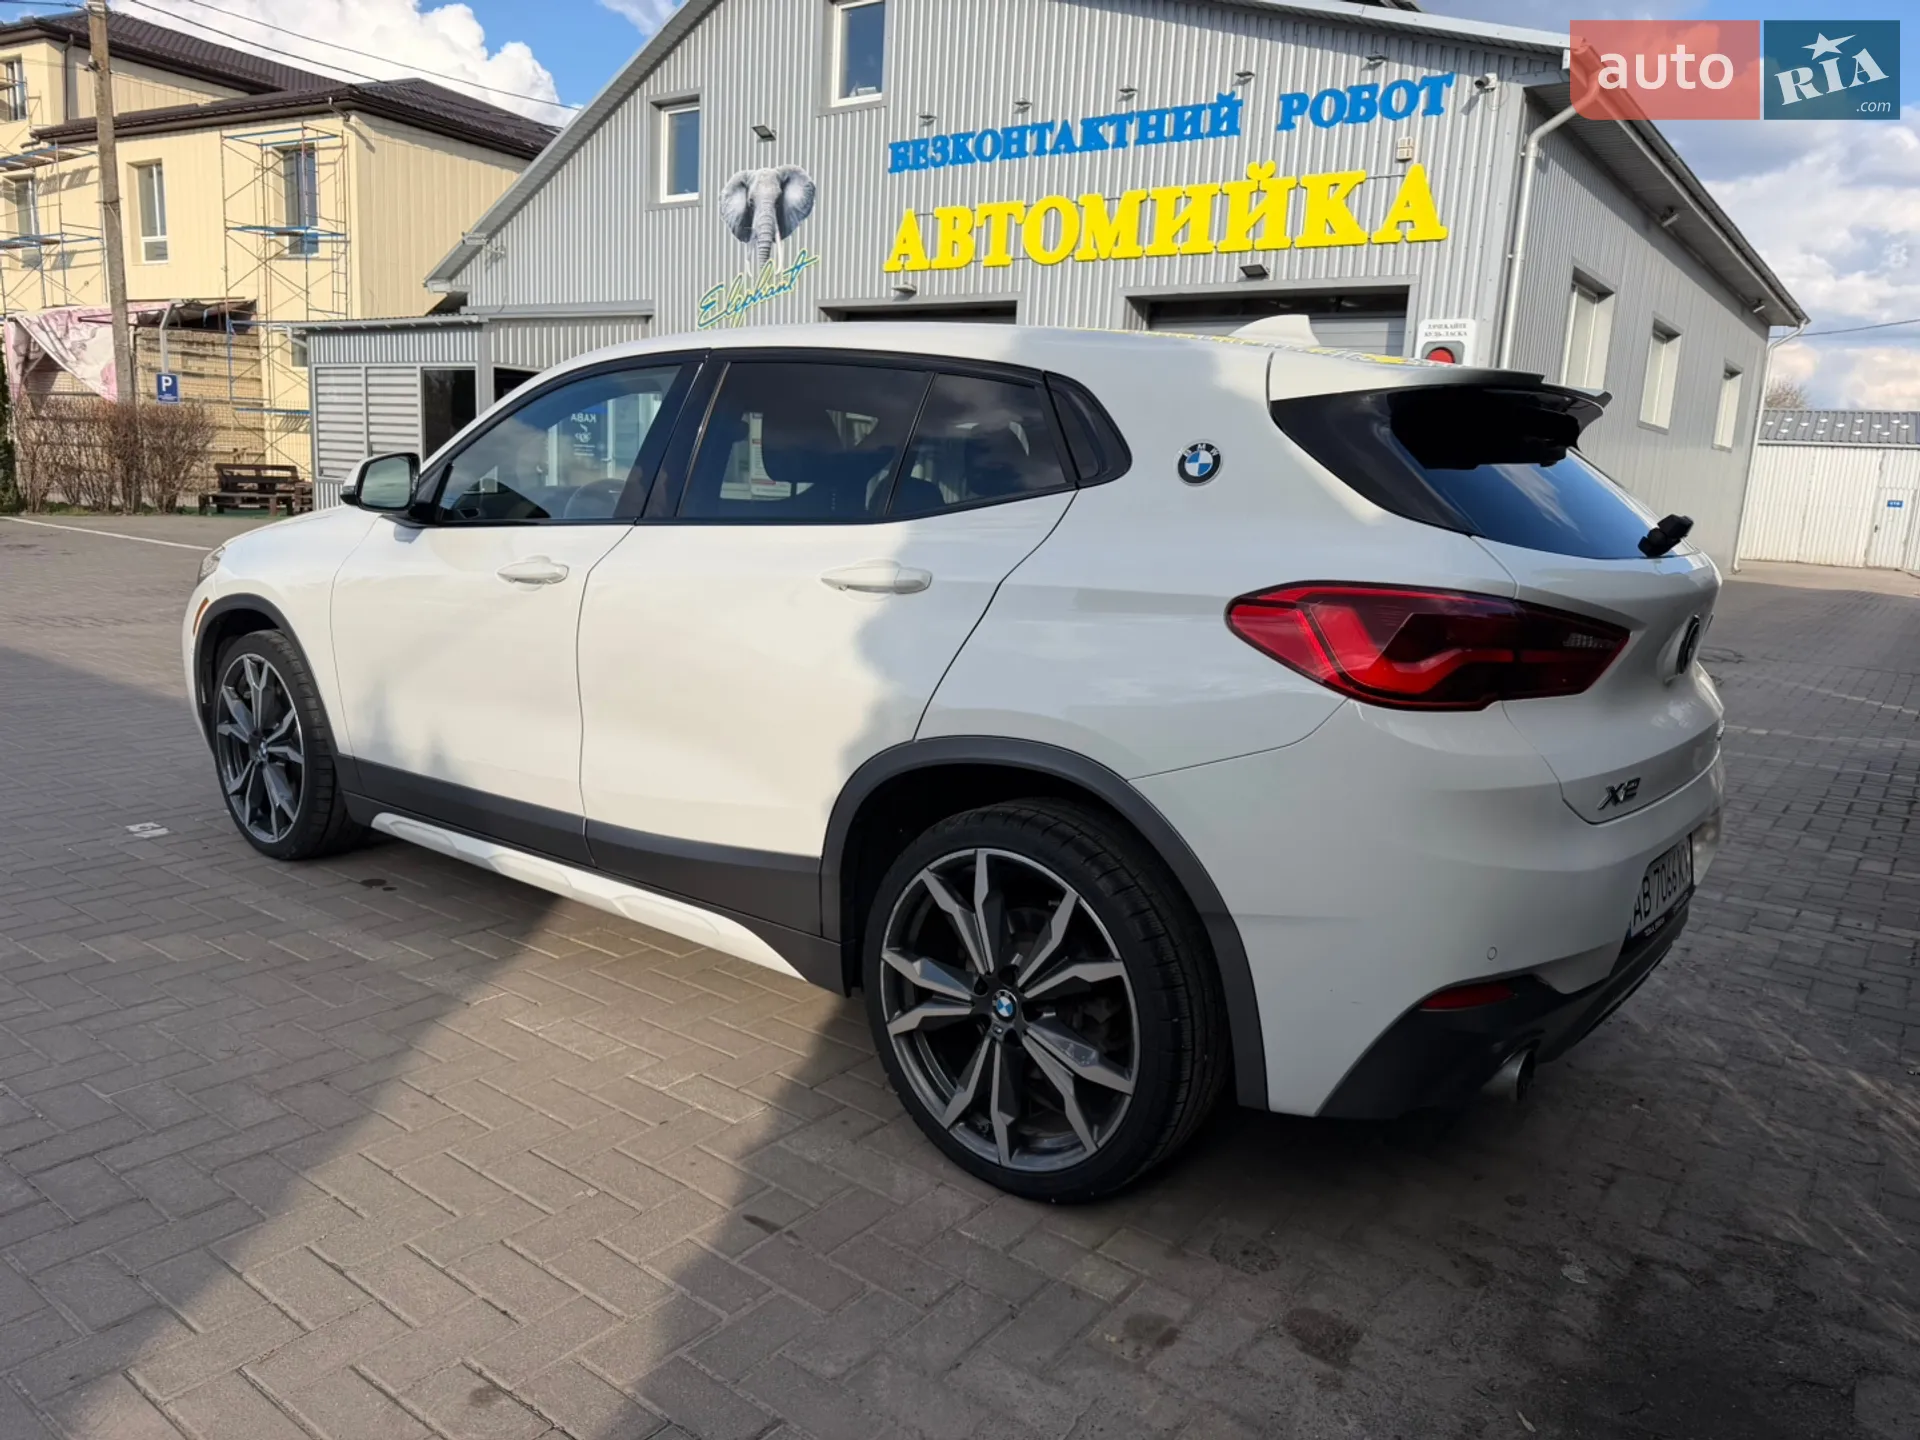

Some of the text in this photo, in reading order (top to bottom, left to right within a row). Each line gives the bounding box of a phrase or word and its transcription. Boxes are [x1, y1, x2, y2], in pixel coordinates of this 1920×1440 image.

[888, 72, 1455, 174] БЕЗКОНТАКТНИЙ РОБОТ
[883, 160, 1448, 272] АВТОМИЙКА
[698, 249, 820, 328] Elephant
[161, 376, 172, 391] P
[1598, 777, 1641, 811] X2
